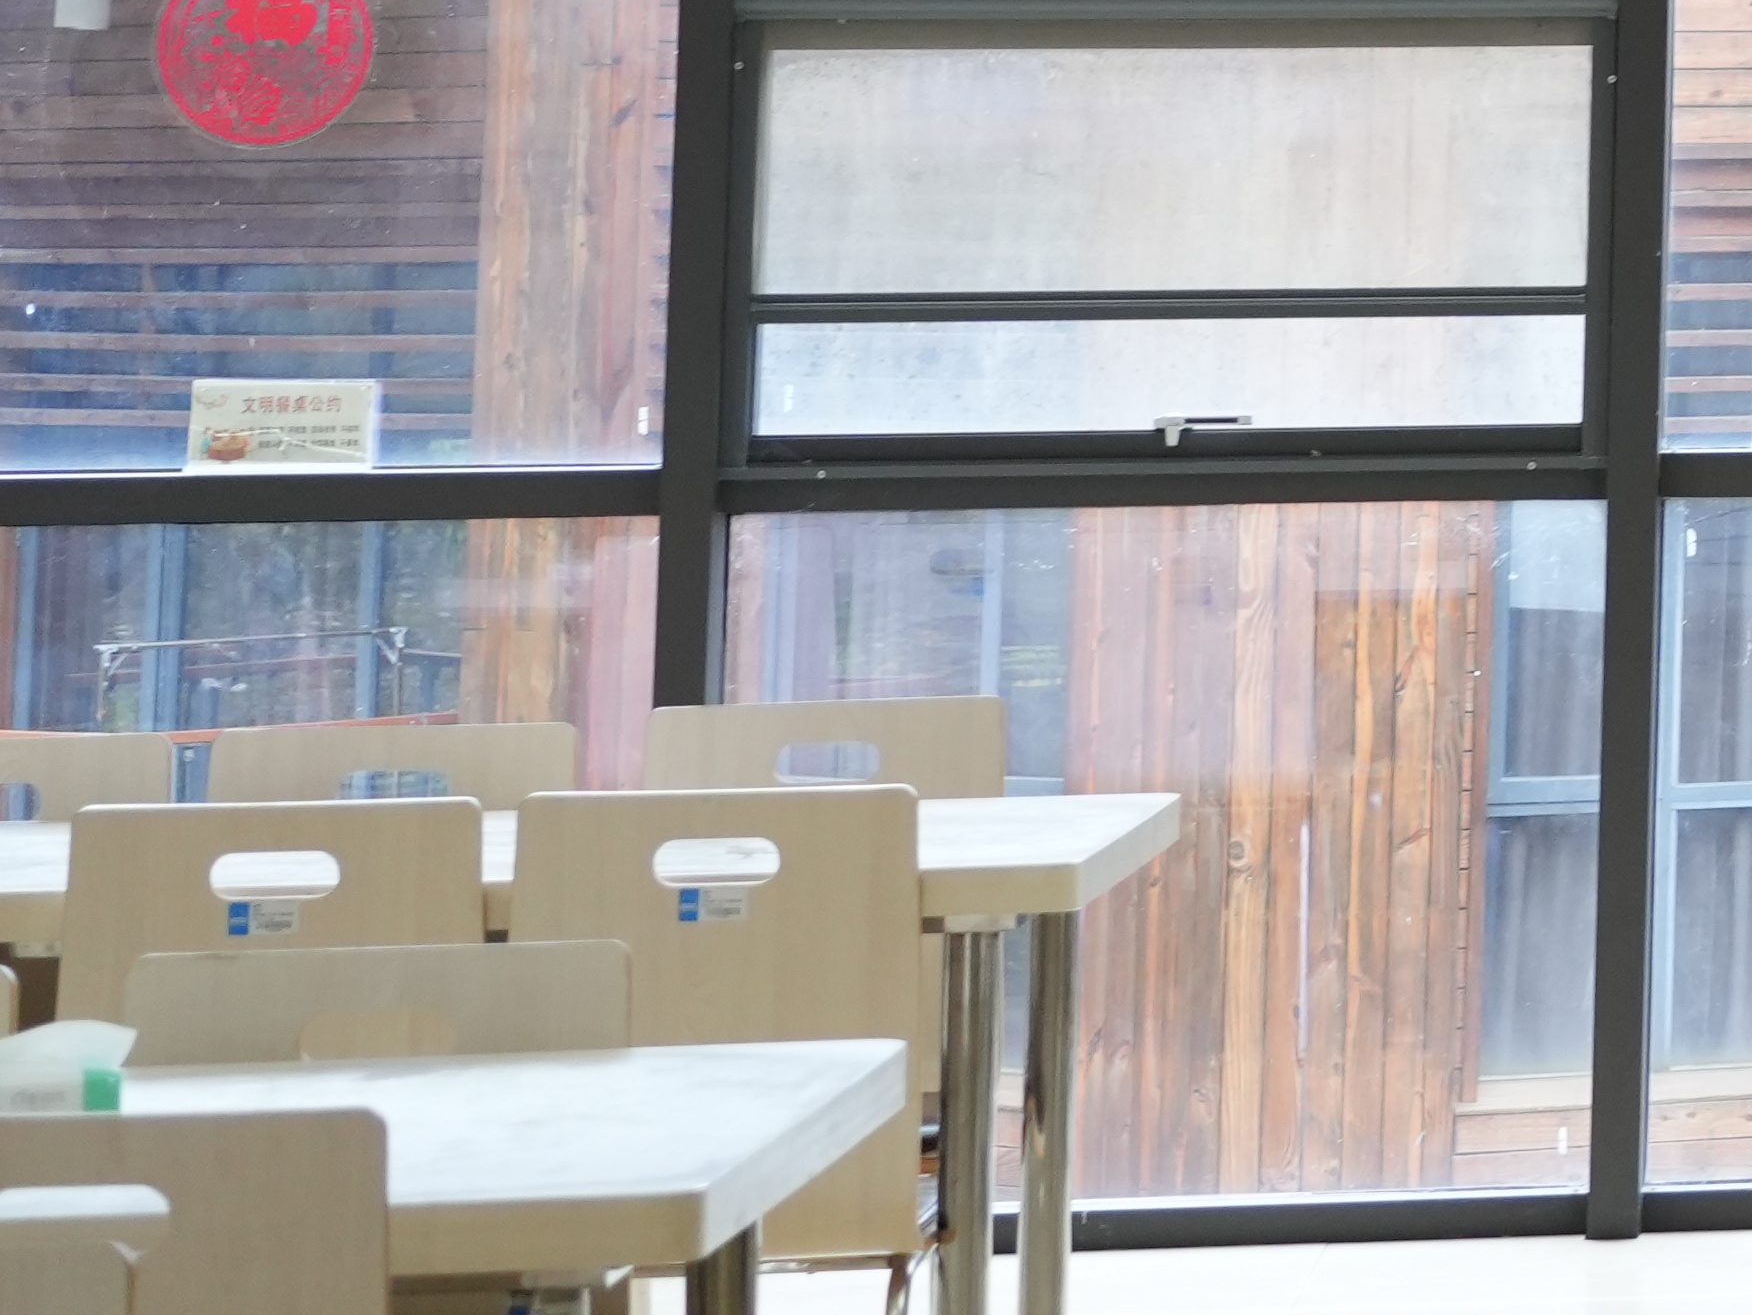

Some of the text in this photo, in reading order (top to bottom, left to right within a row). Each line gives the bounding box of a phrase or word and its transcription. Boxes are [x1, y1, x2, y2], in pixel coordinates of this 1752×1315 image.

[241, 395, 342, 413] 文明餐桌公约
